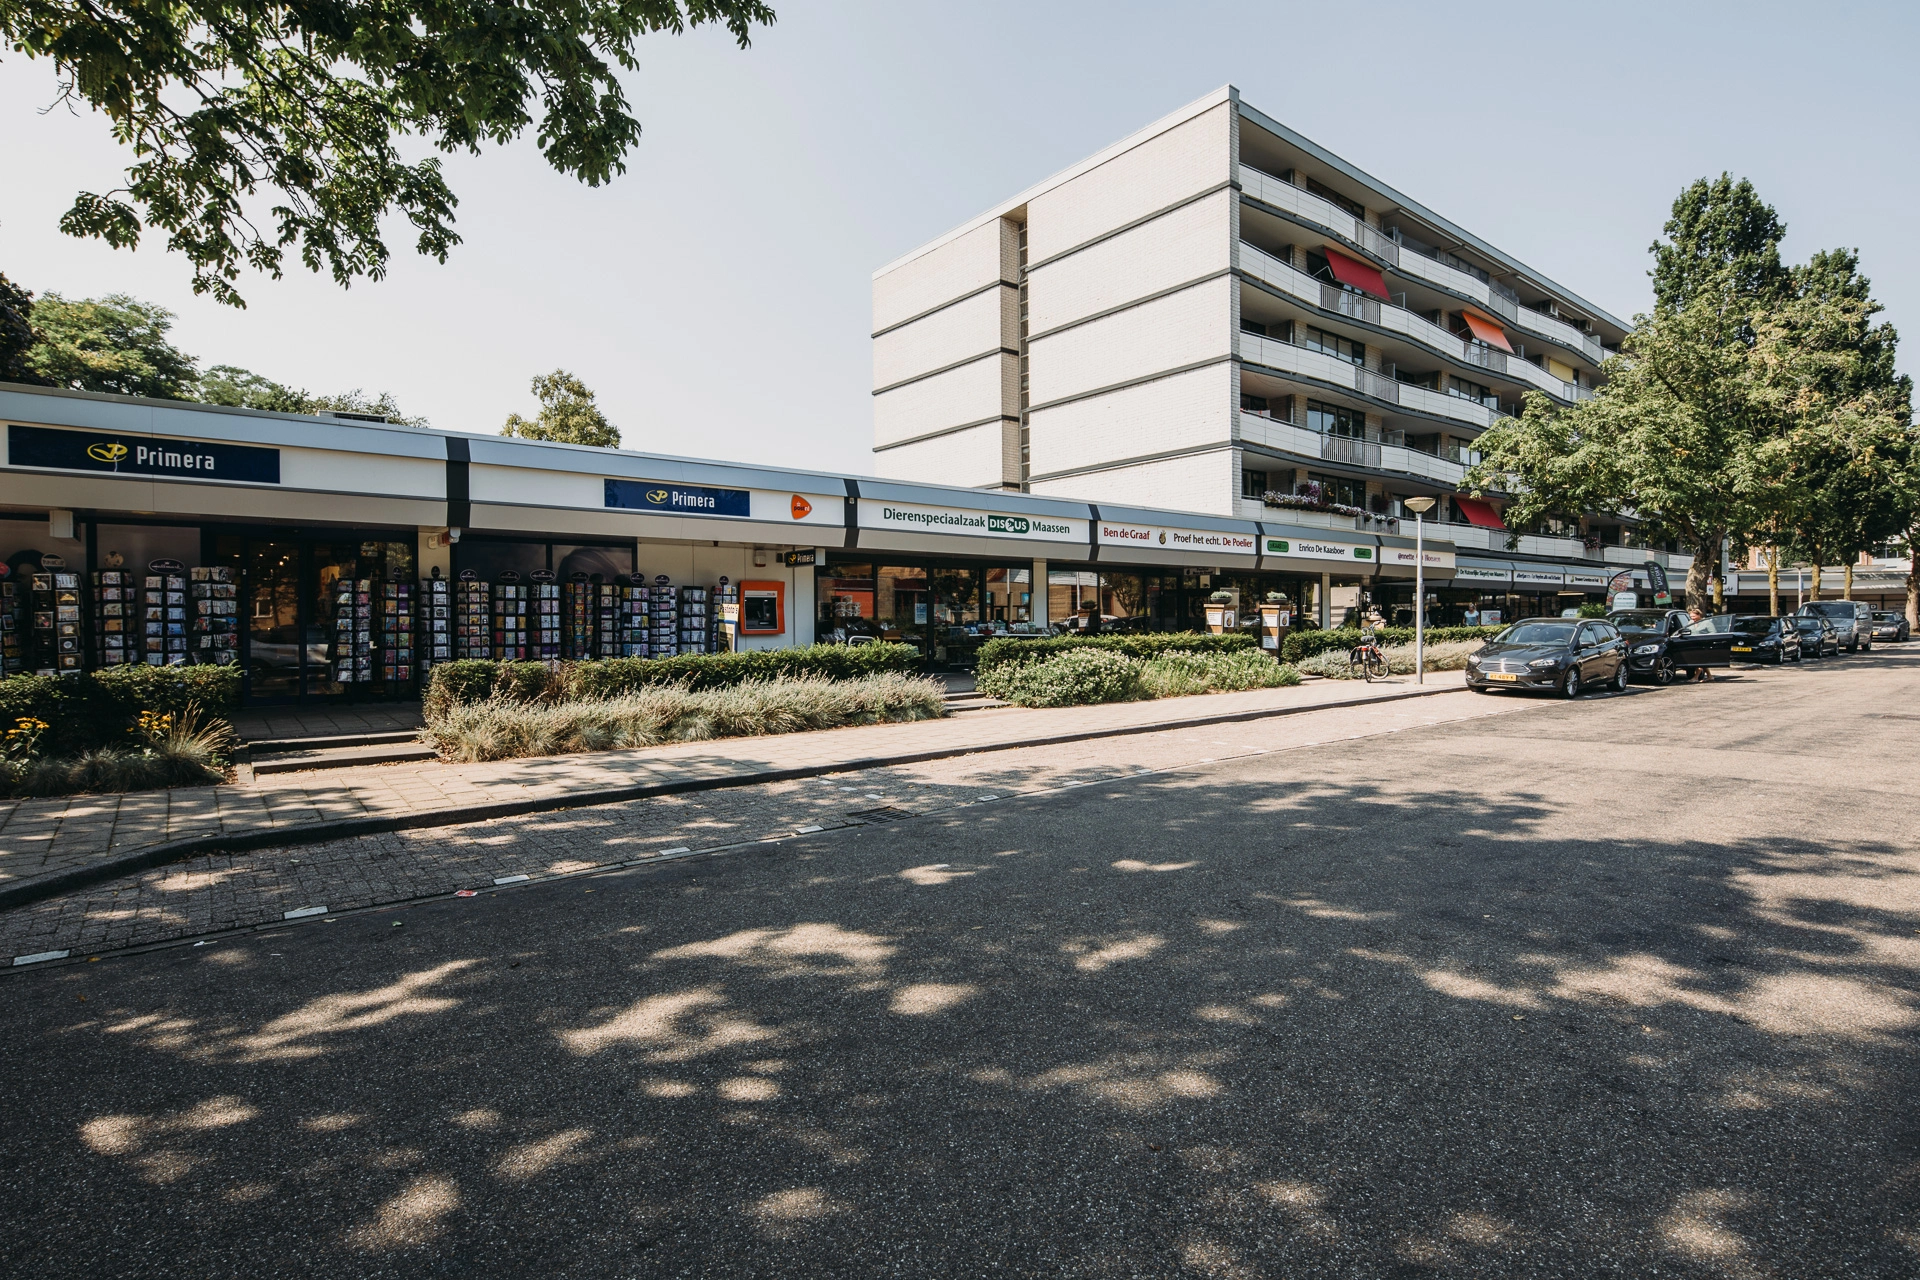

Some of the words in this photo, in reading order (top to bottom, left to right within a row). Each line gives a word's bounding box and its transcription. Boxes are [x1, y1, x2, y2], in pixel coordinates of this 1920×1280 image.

[136, 445, 215, 470] Primera
[672, 491, 715, 508] Primera
[883, 507, 986, 527] Dierenspeciaalzaak
[989, 517, 1027, 532] DISCUS
[1032, 521, 1070, 534] Maassen
[1103, 527, 1119, 538] Ben
[1119, 528, 1130, 539] de
[1129, 529, 1151, 540] Graaf
[1173, 533, 1192, 544] Proef
[1192, 534, 1204, 545] het
[1205, 536, 1221, 546] echt.
[1222, 537, 1232, 546] De
[1232, 538, 1253, 548] Poelier
[1298, 543, 1315, 552] Enrico
[1315, 545, 1323, 553] De
[1323, 546, 1346, 555] Kaasboer
[797, 553, 814, 563] Primera
